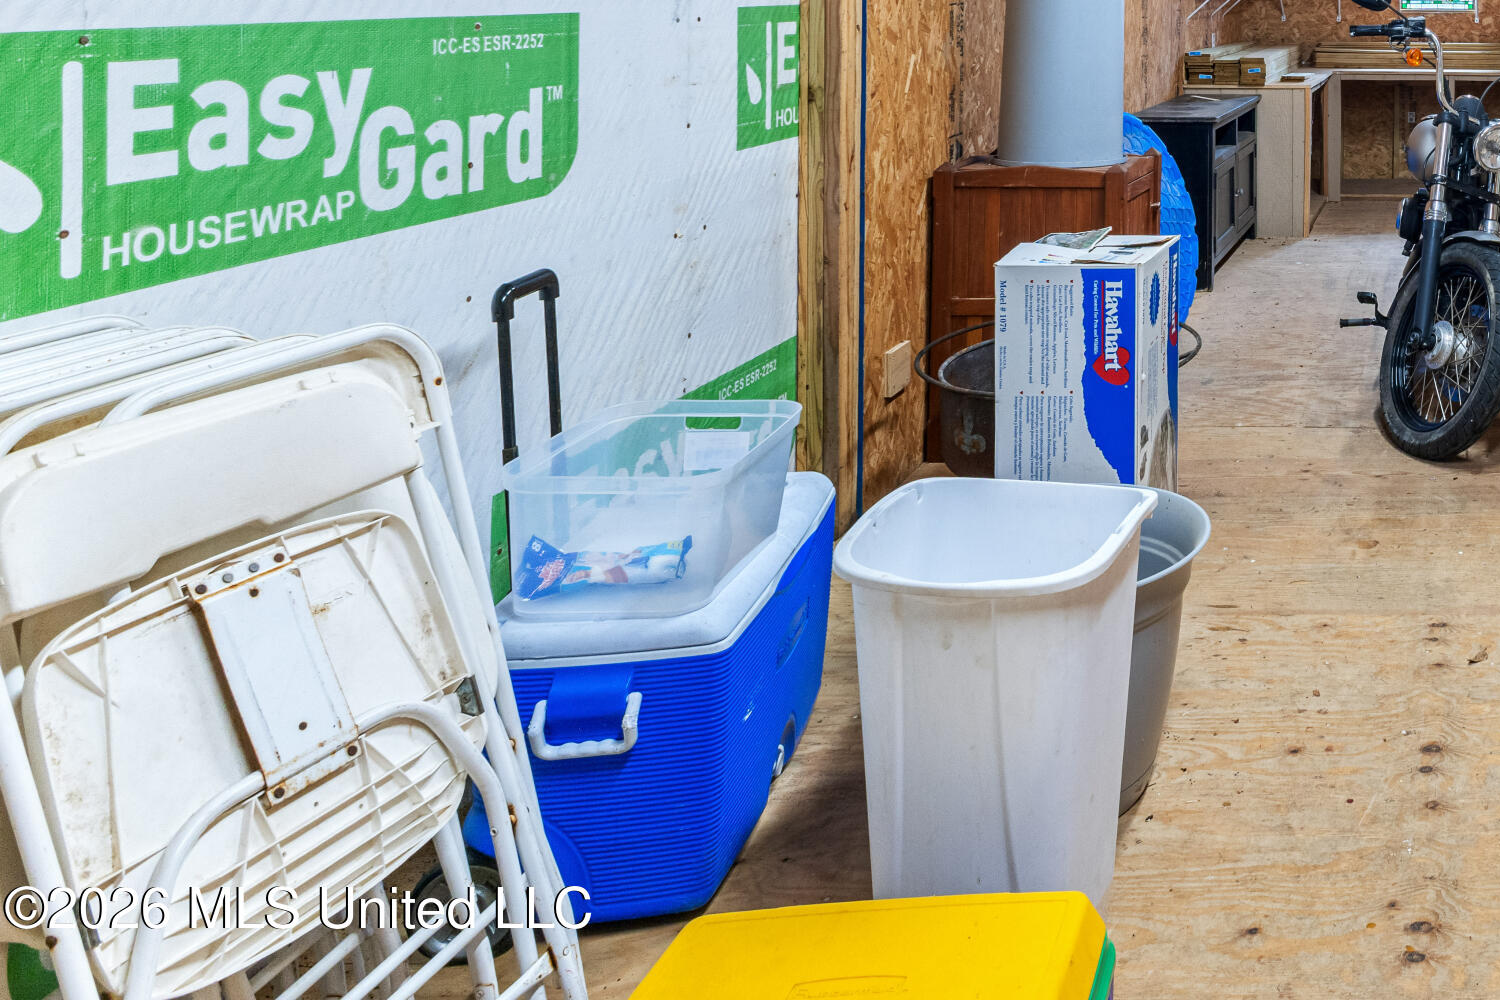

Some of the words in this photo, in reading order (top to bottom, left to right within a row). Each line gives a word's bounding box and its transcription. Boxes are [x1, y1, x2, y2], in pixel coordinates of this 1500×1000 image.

[432, 35, 481, 56] ICC-ES
[482, 33, 545, 53] ESR-2252
[102, 190, 357, 271] HOUSEWRAP
[999, 280, 1007, 304] Model
[999, 314, 1007, 333] 1079
[1104, 279, 1123, 372] Havahart
[744, 359, 778, 388] ESR-2252
